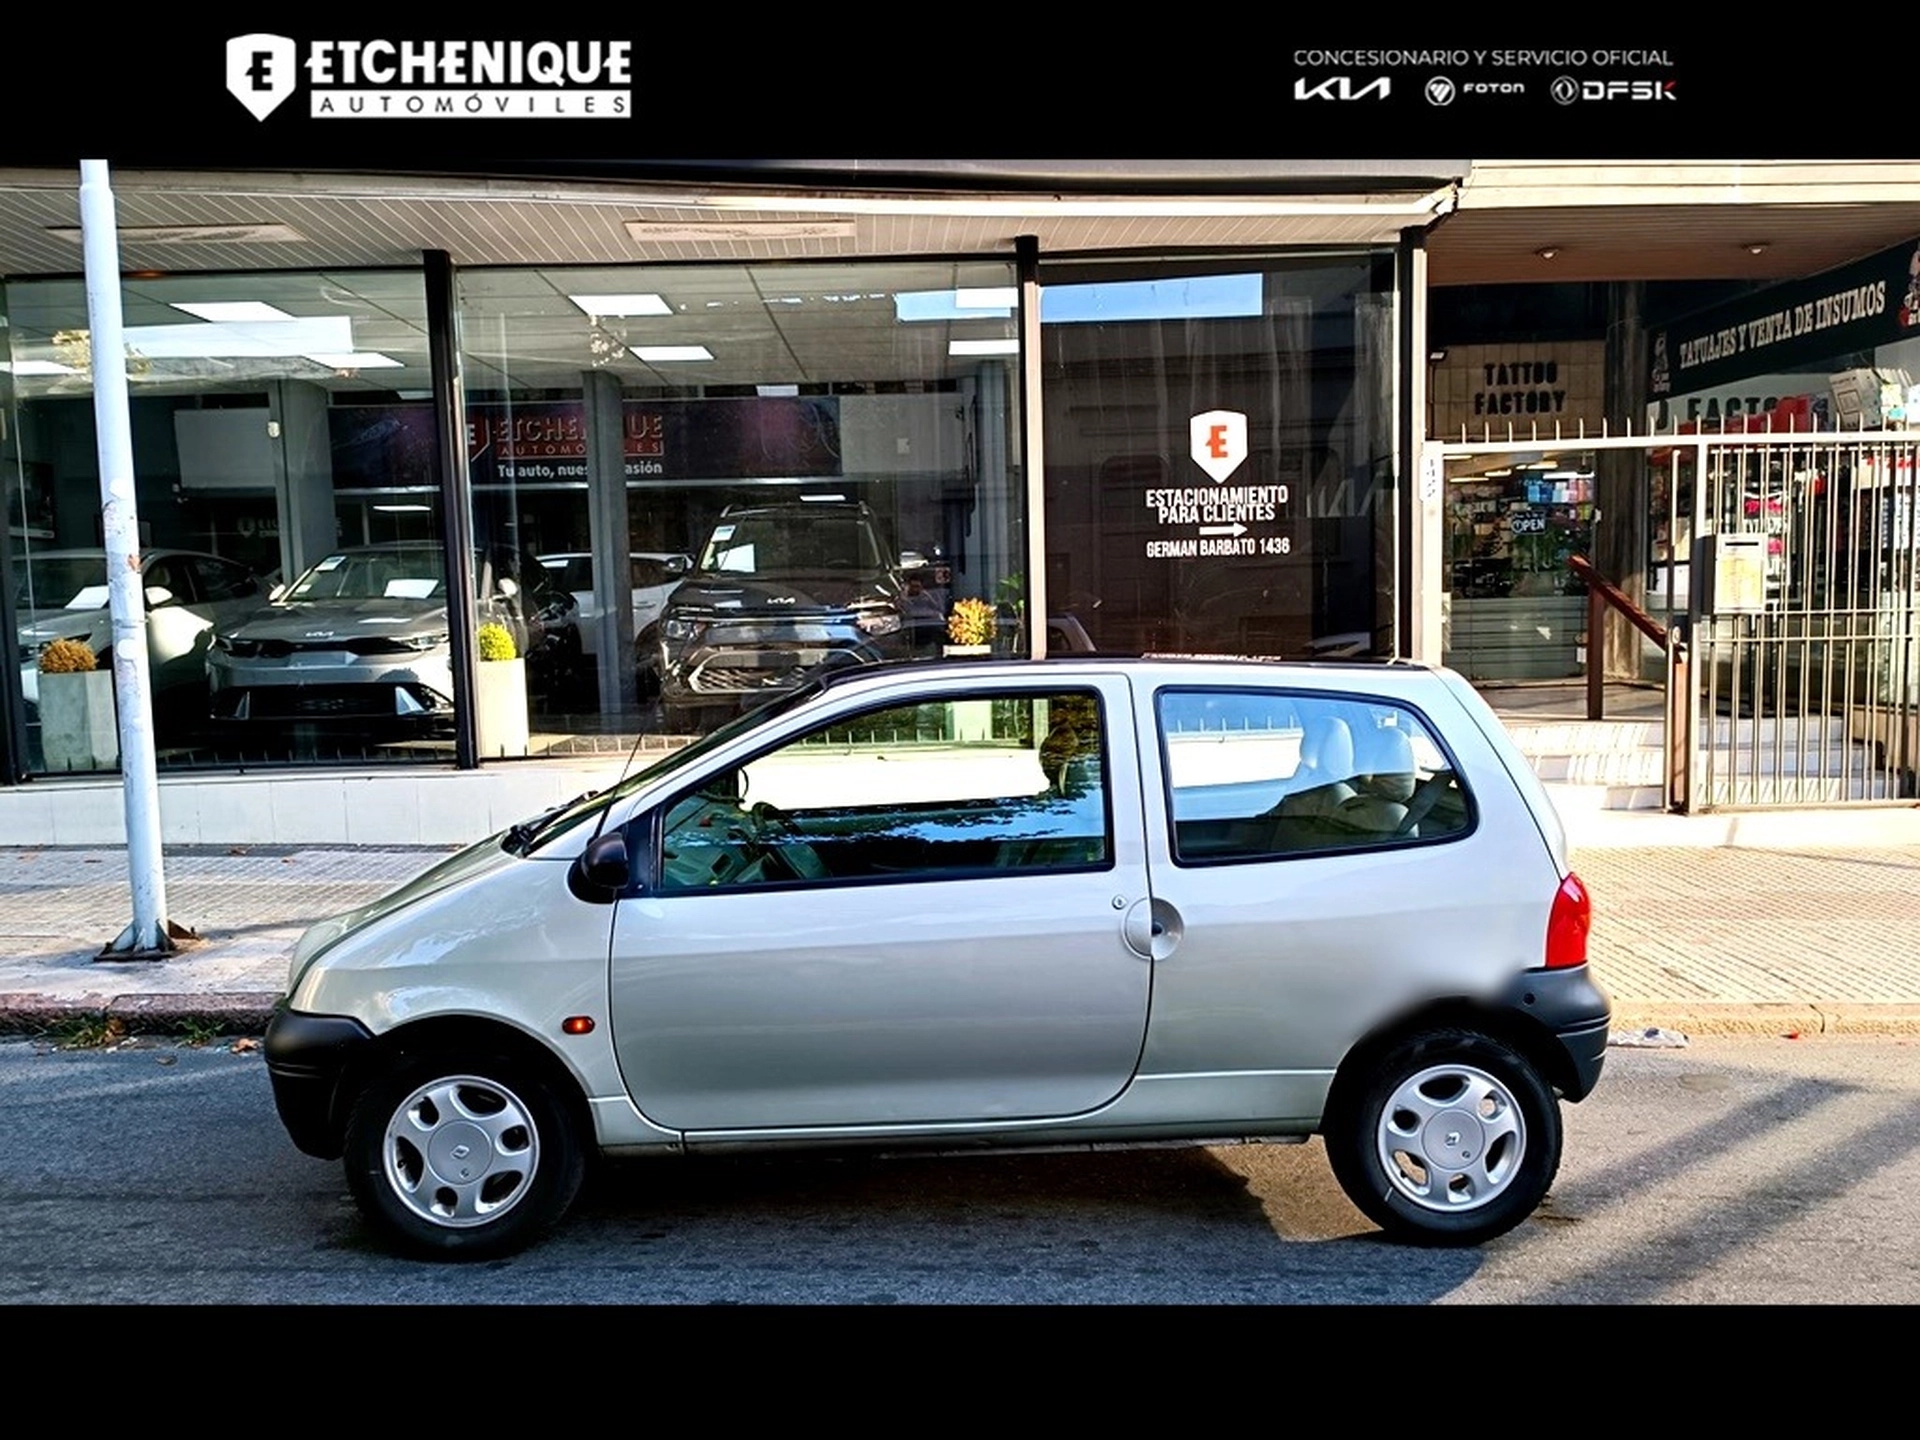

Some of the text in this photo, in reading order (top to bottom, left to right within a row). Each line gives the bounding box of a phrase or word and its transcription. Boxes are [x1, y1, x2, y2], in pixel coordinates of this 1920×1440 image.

[1679, 325, 1737, 369] TATUAJES
[1737, 321, 1747, 352] Y
[1749, 308, 1792, 349] VENTA
[1794, 302, 1814, 337] DE
[1815, 280, 1887, 329] INSUMOS
[1484, 361, 1558, 386] TATTOO
[1474, 391, 1566, 416] FACTORY
[492, 415, 663, 443] ETCHEUE
[497, 464, 515, 478] Tu
[518, 464, 555, 479] auto,
[1146, 485, 1289, 507] ESTACIONAMIENTO
[1158, 503, 1275, 524] PARA CLIENTES
[1511, 518, 1546, 533] OPEN
[1146, 540, 1197, 558] GERMAN
[1200, 538, 1256, 556] BARBATO
